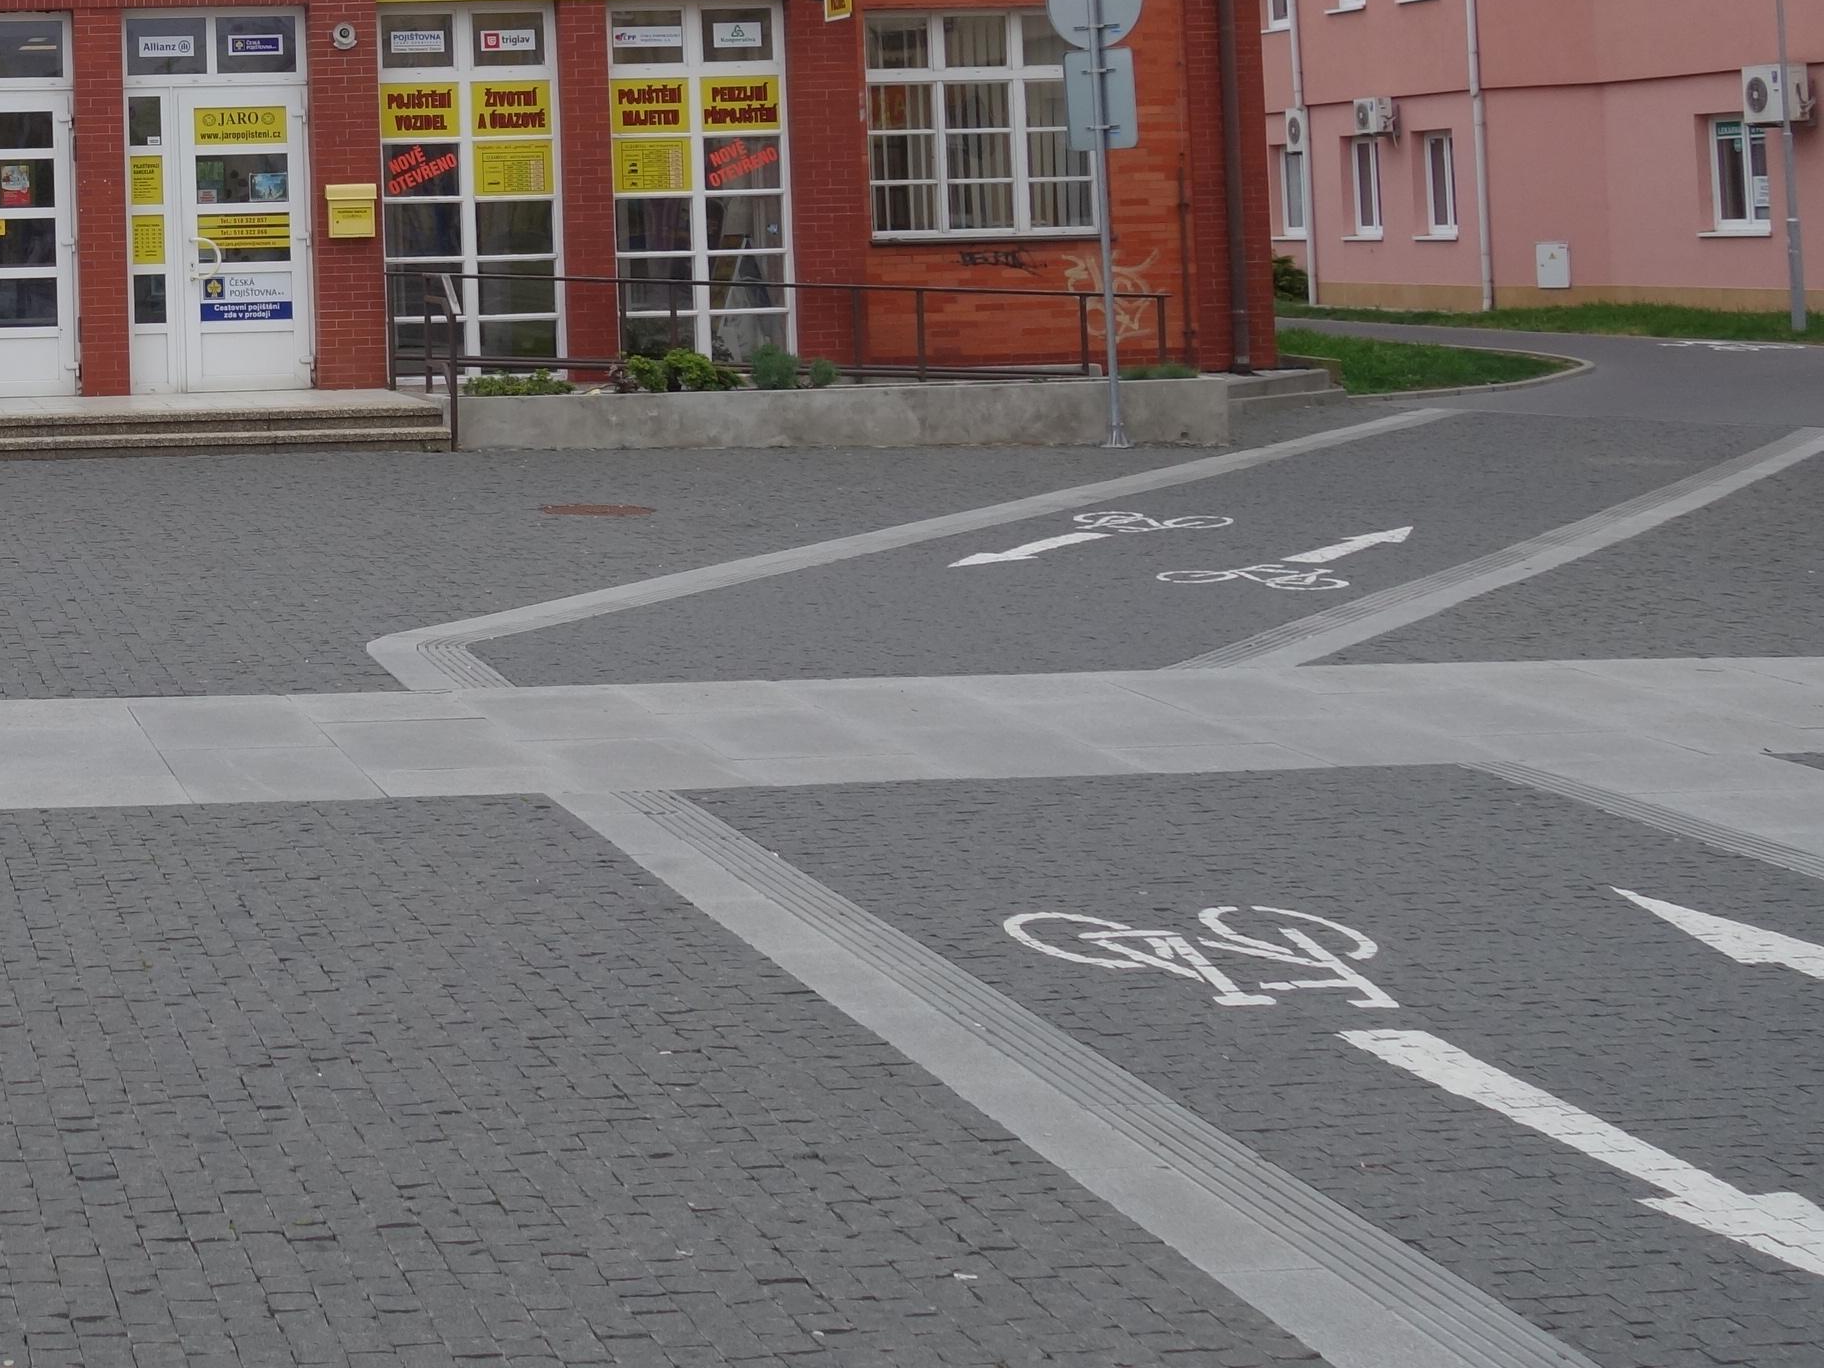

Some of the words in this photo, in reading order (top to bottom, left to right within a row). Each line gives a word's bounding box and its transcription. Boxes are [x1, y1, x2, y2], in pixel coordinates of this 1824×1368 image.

[393, 32, 441, 42] POJIŠŤOVNA
[502, 35, 530, 46] triglav
[143, 43, 176, 52] Allianz
[387, 89, 452, 109] POJIŠTĚNÍ
[485, 87, 539, 107] ŽIVOTNÍ
[618, 84, 683, 104] POJIŠTĚNÍ
[712, 82, 768, 102] PENZIJNÍ
[218, 111, 259, 126] JARO
[395, 114, 447, 131] VOZIDEL
[478, 113, 487, 129] A
[490, 109, 545, 129] ÚRAZOVÉ
[622, 109, 680, 126] MAJETKU
[704, 103, 778, 124] PŘIPOJIŠTĚNÍ
[389, 144, 425, 175] NOVĚ
[709, 138, 747, 167] NOVĚ
[388, 152, 458, 195] OTEVŘENO
[709, 146, 778, 187] OTEVŘENO
[230, 277, 255, 286] ČESKÁ
[230, 288, 276, 297] POJIŠŤOVNA
[214, 303, 246, 311] Cestovní
[248, 302, 280, 311] pojištění
[244, 311, 270, 319] prodeji
